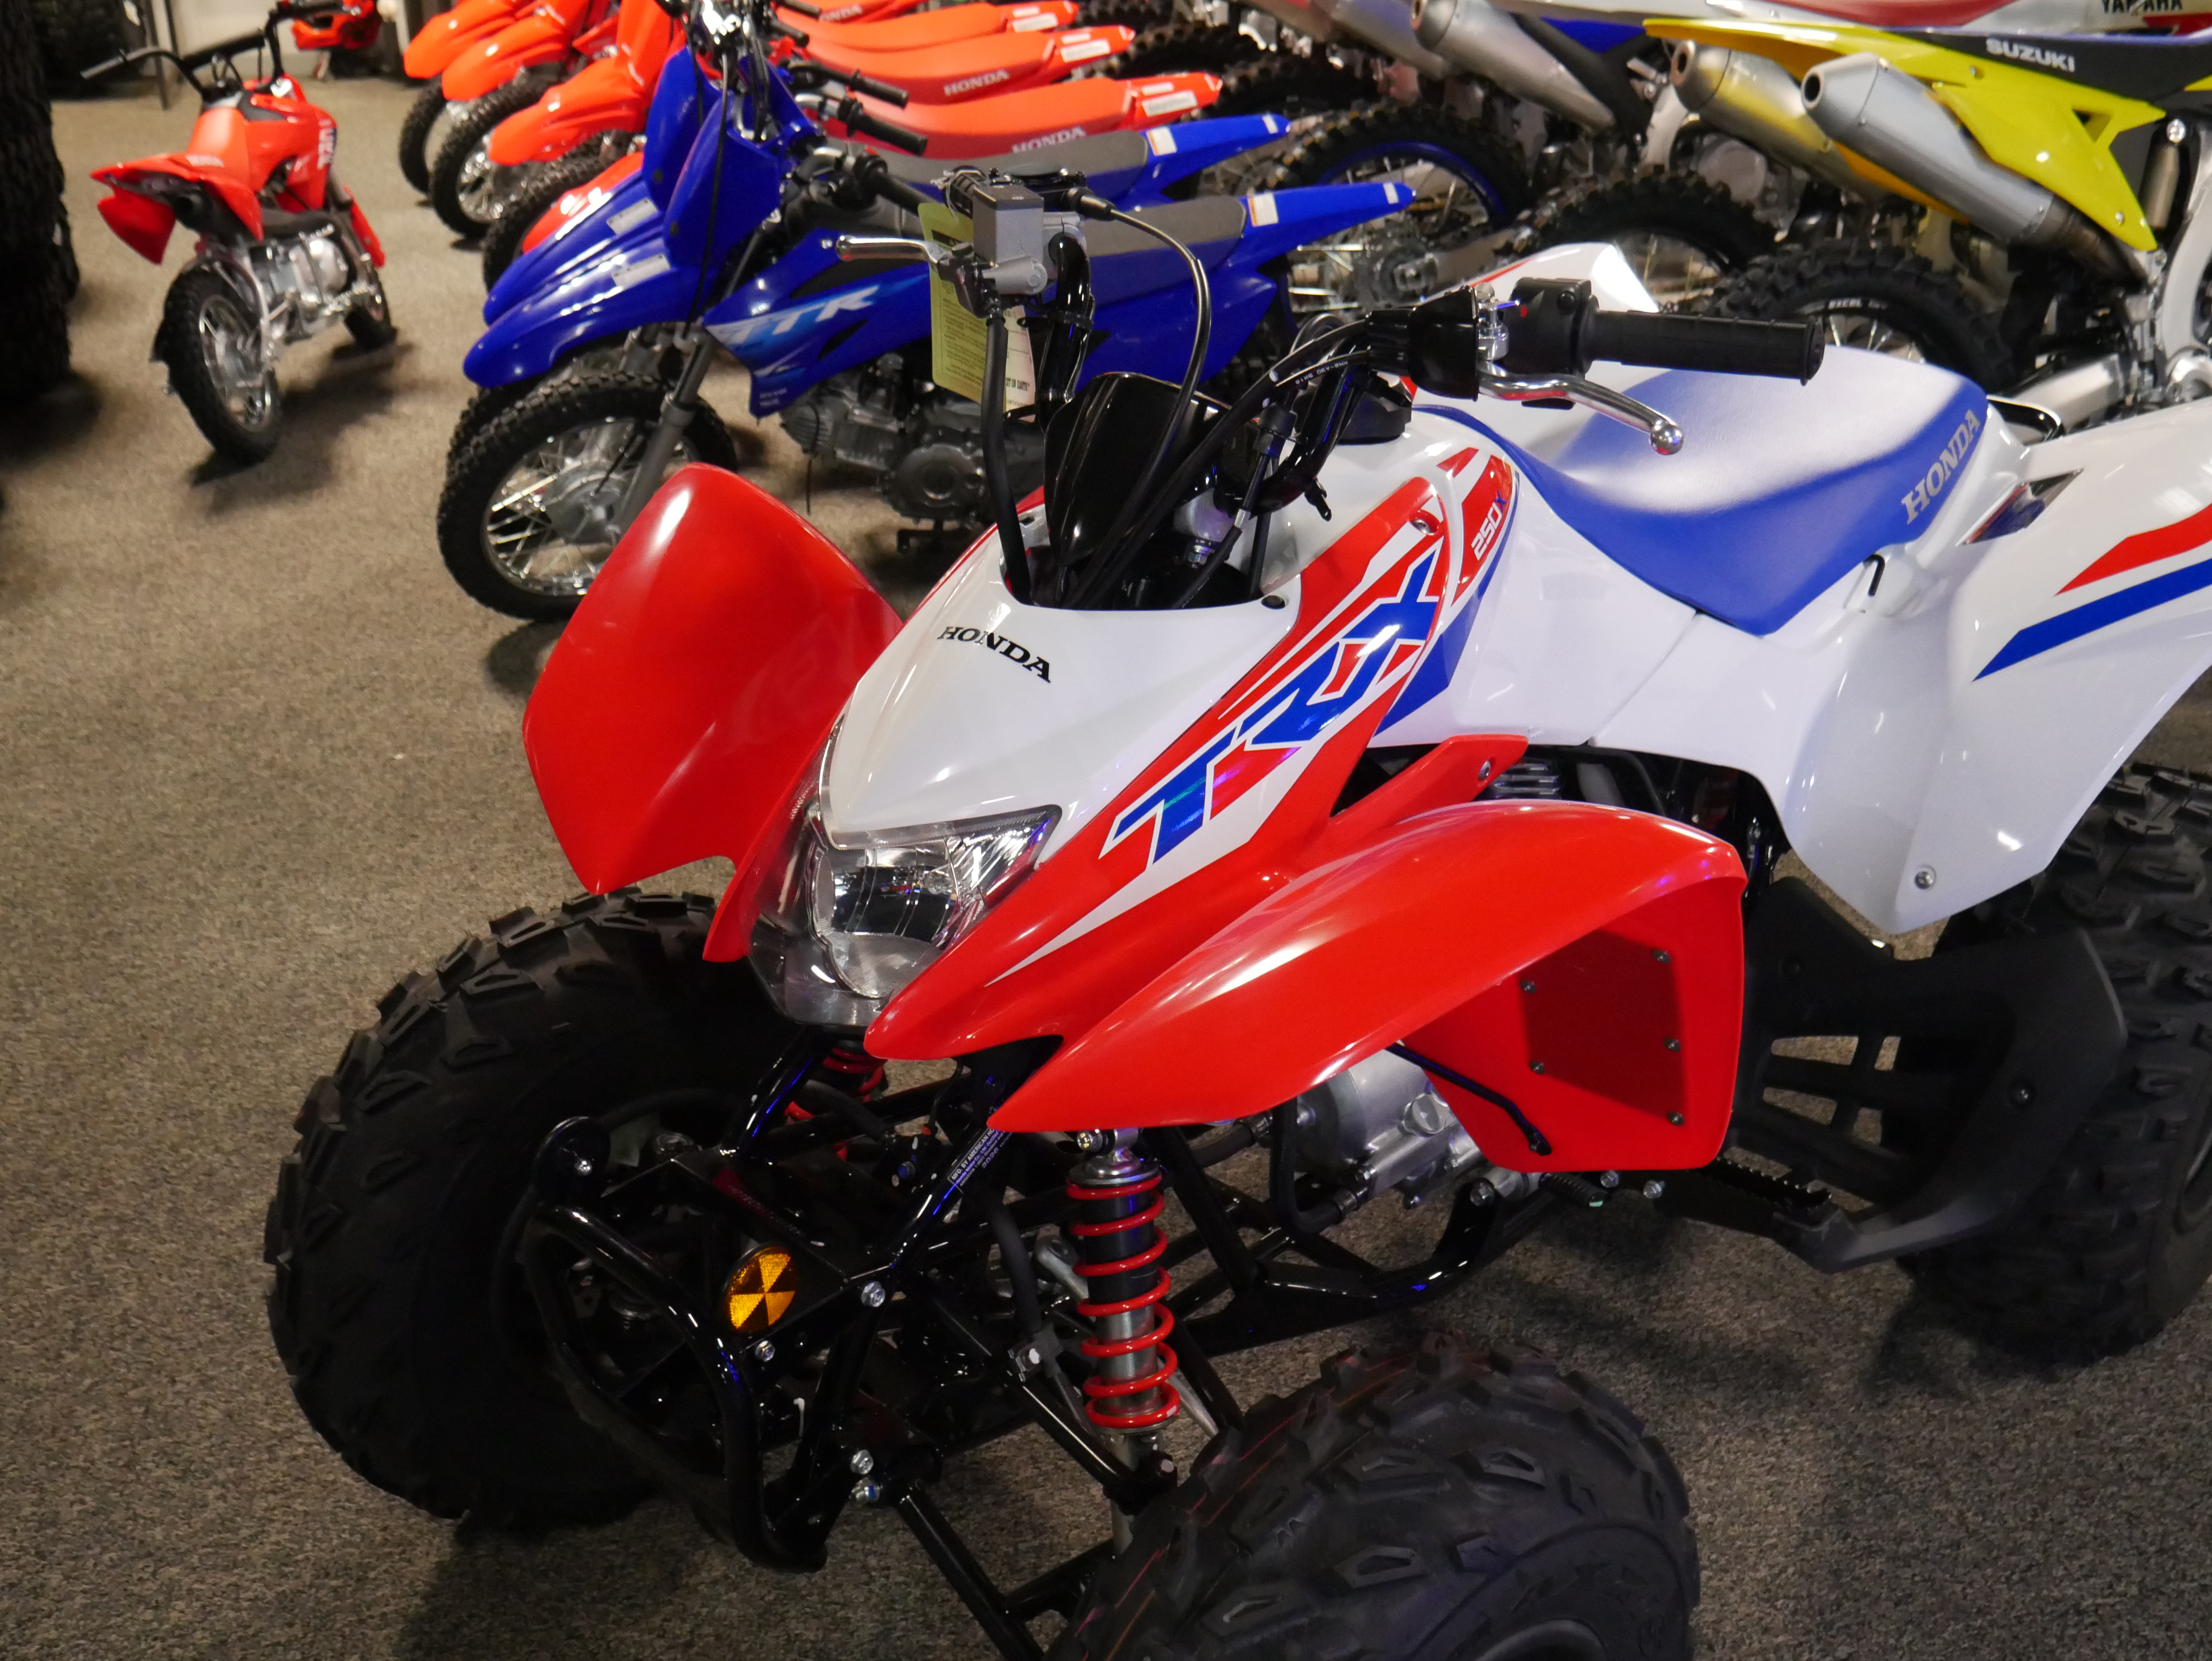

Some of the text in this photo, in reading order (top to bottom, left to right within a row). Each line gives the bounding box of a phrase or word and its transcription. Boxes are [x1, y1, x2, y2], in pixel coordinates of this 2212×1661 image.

[1986, 38, 2075, 72] SUZUKI
[944, 69, 1010, 96] HONDA
[1012, 125, 1086, 153] HONDA
[1901, 409, 1981, 525] HONDA
[936, 626, 1051, 683] HONDA
[1099, 536, 1444, 865] TRX
[960, 1159, 969, 1169] BY
[966, 1134, 989, 1161] AMERICAN
